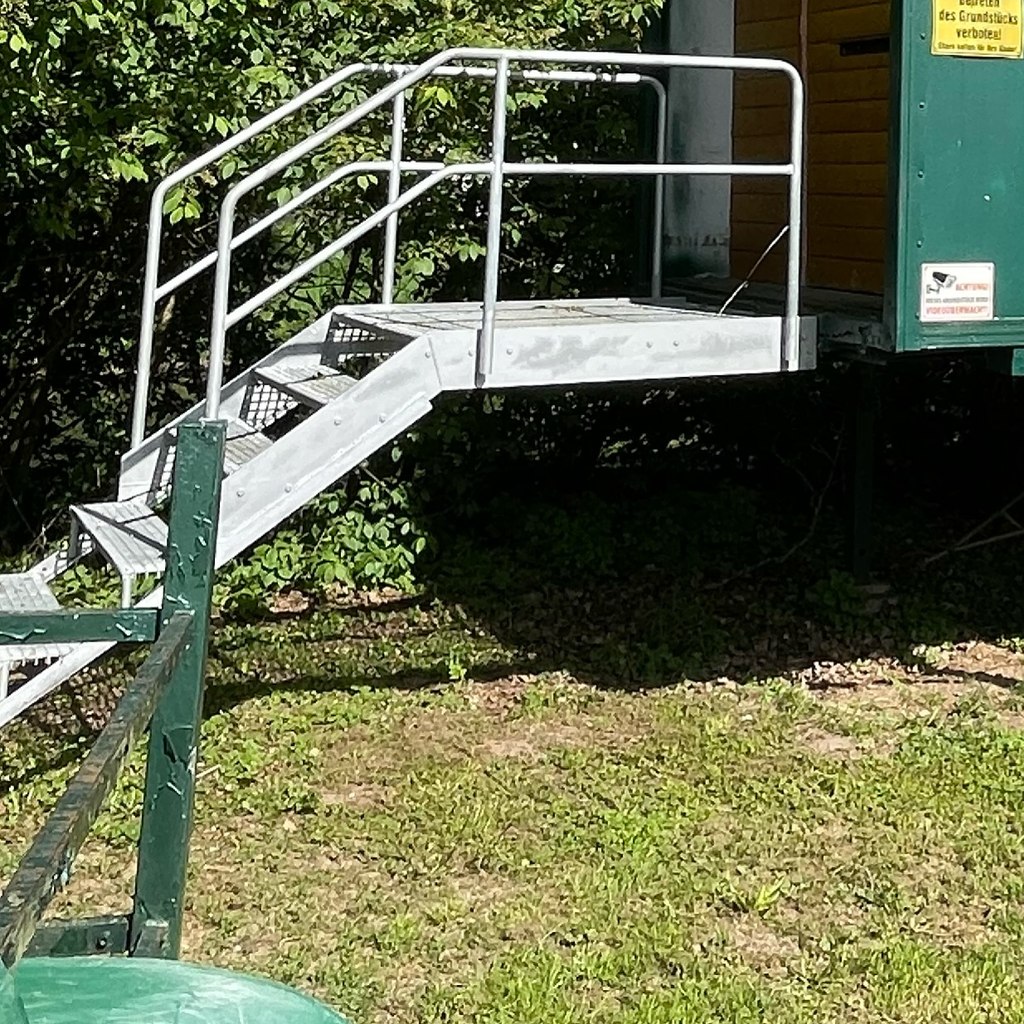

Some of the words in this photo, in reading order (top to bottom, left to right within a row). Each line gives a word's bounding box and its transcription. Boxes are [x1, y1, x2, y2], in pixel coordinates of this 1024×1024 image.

[939, 9, 956, 22] des
[958, 10, 1018, 25] Grundstücks
[956, 27, 1002, 41] verboten!
